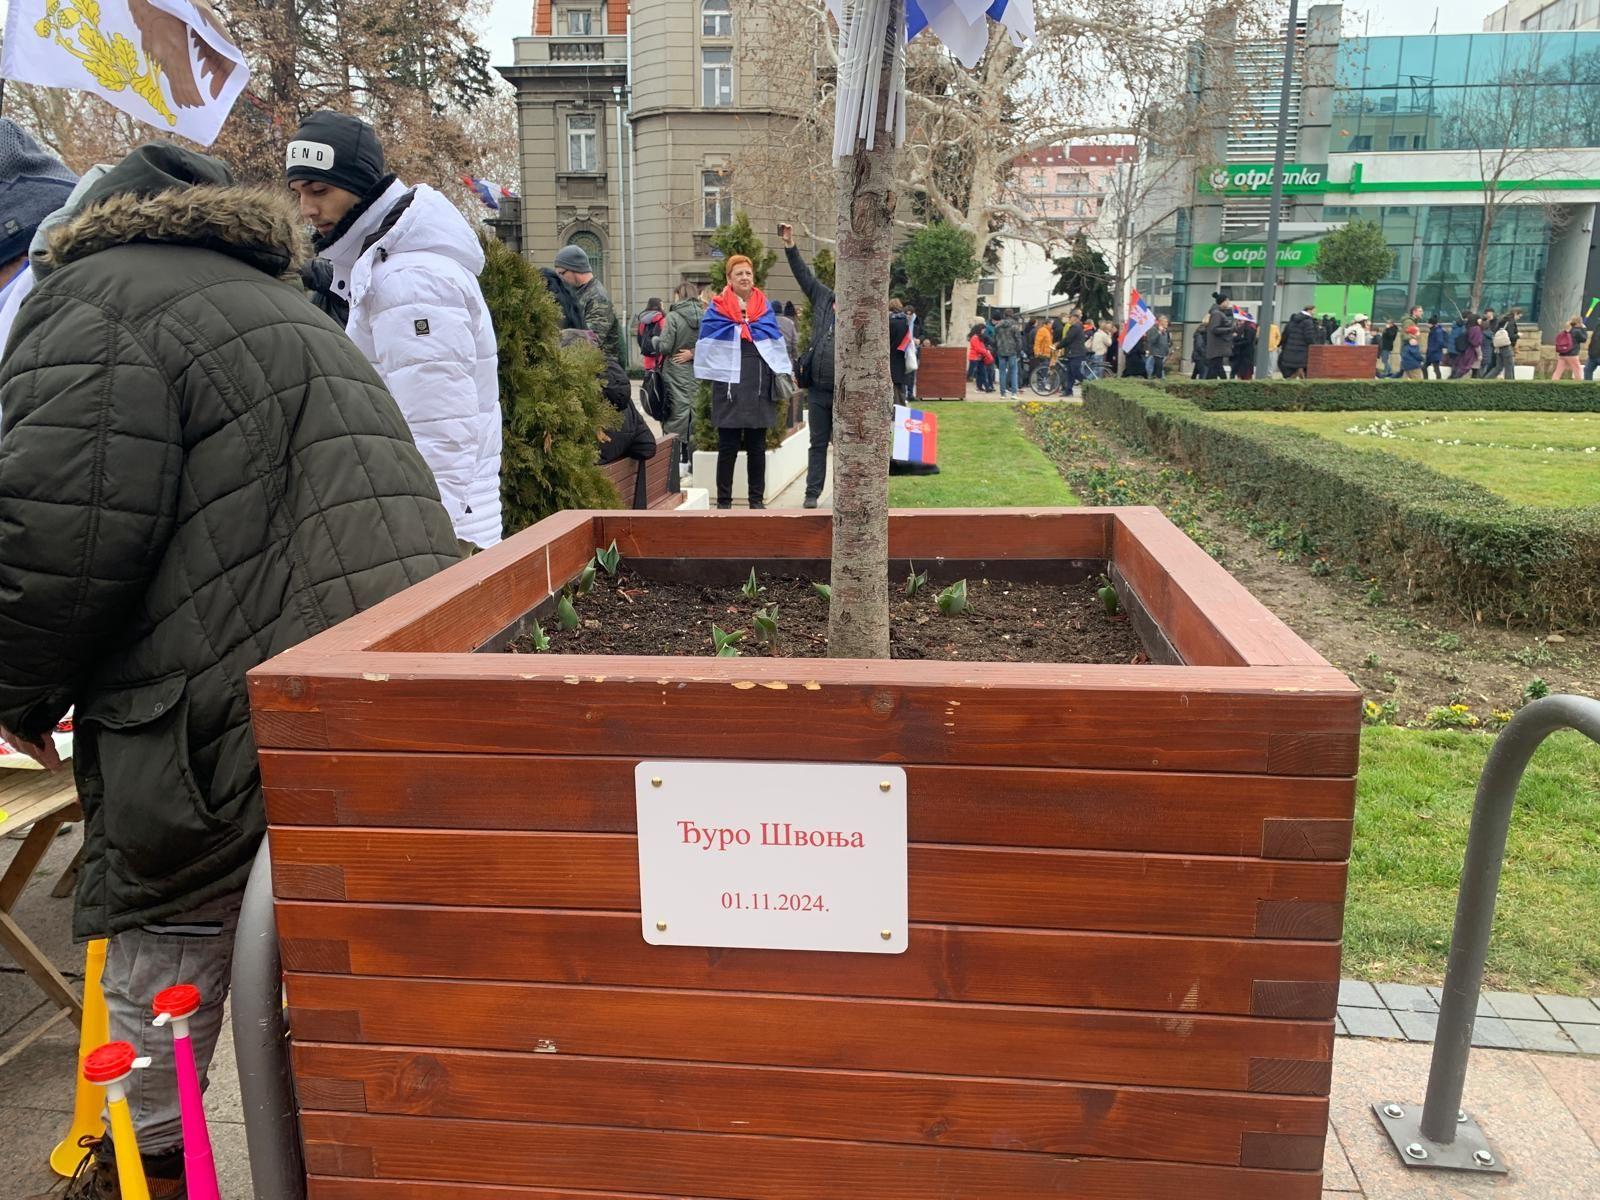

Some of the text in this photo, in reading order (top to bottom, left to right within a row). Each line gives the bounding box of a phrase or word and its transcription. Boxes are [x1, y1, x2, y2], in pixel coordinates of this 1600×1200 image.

[287, 147, 324, 162] END
[1232, 246, 1302, 264] otpbnka
[677, 820, 866, 851] Ђуро Швоња
[721, 891, 830, 912] 01.11.2024.
